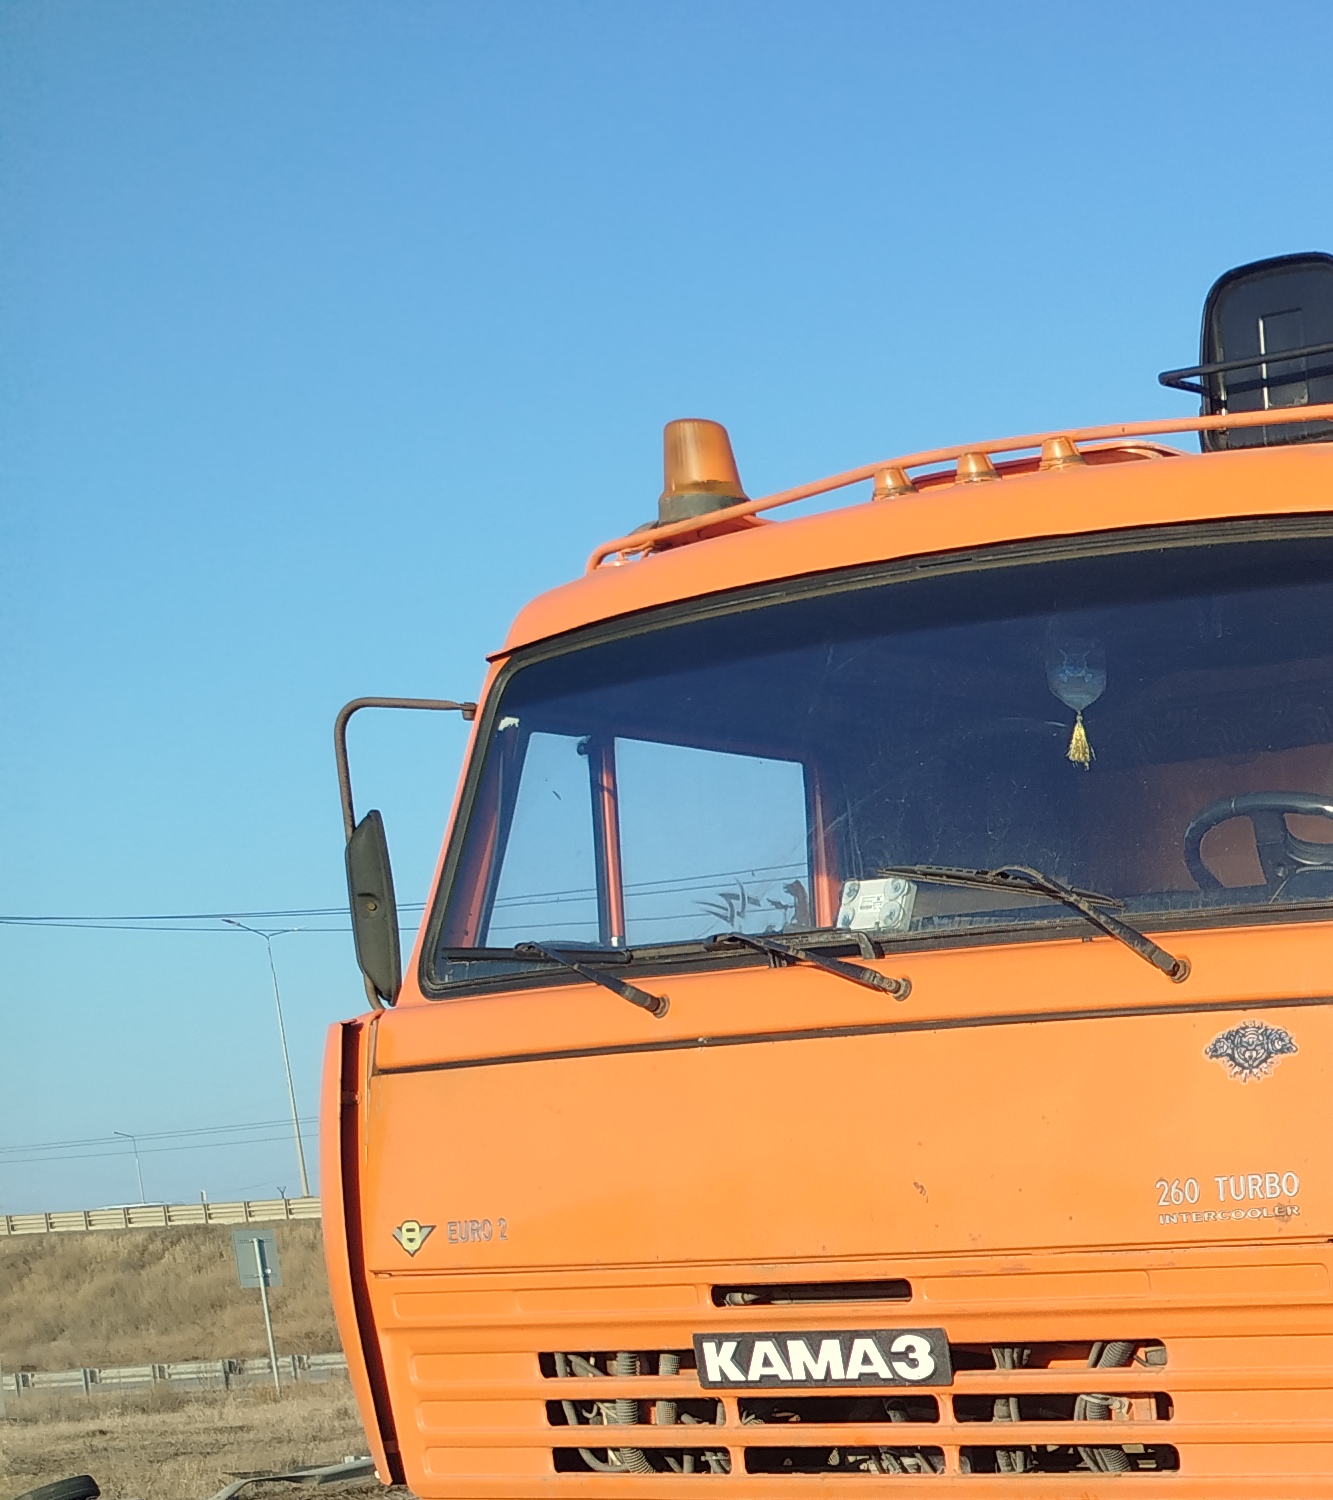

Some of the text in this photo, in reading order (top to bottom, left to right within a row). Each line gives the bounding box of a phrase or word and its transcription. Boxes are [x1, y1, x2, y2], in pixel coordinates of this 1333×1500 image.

[1155, 1171, 1300, 1206] 260 TURBO
[1158, 1204, 1300, 1225] INTERCOOLER
[447, 1218, 508, 1245] EURO 2
[702, 1334, 936, 1382] КАМАЗ
